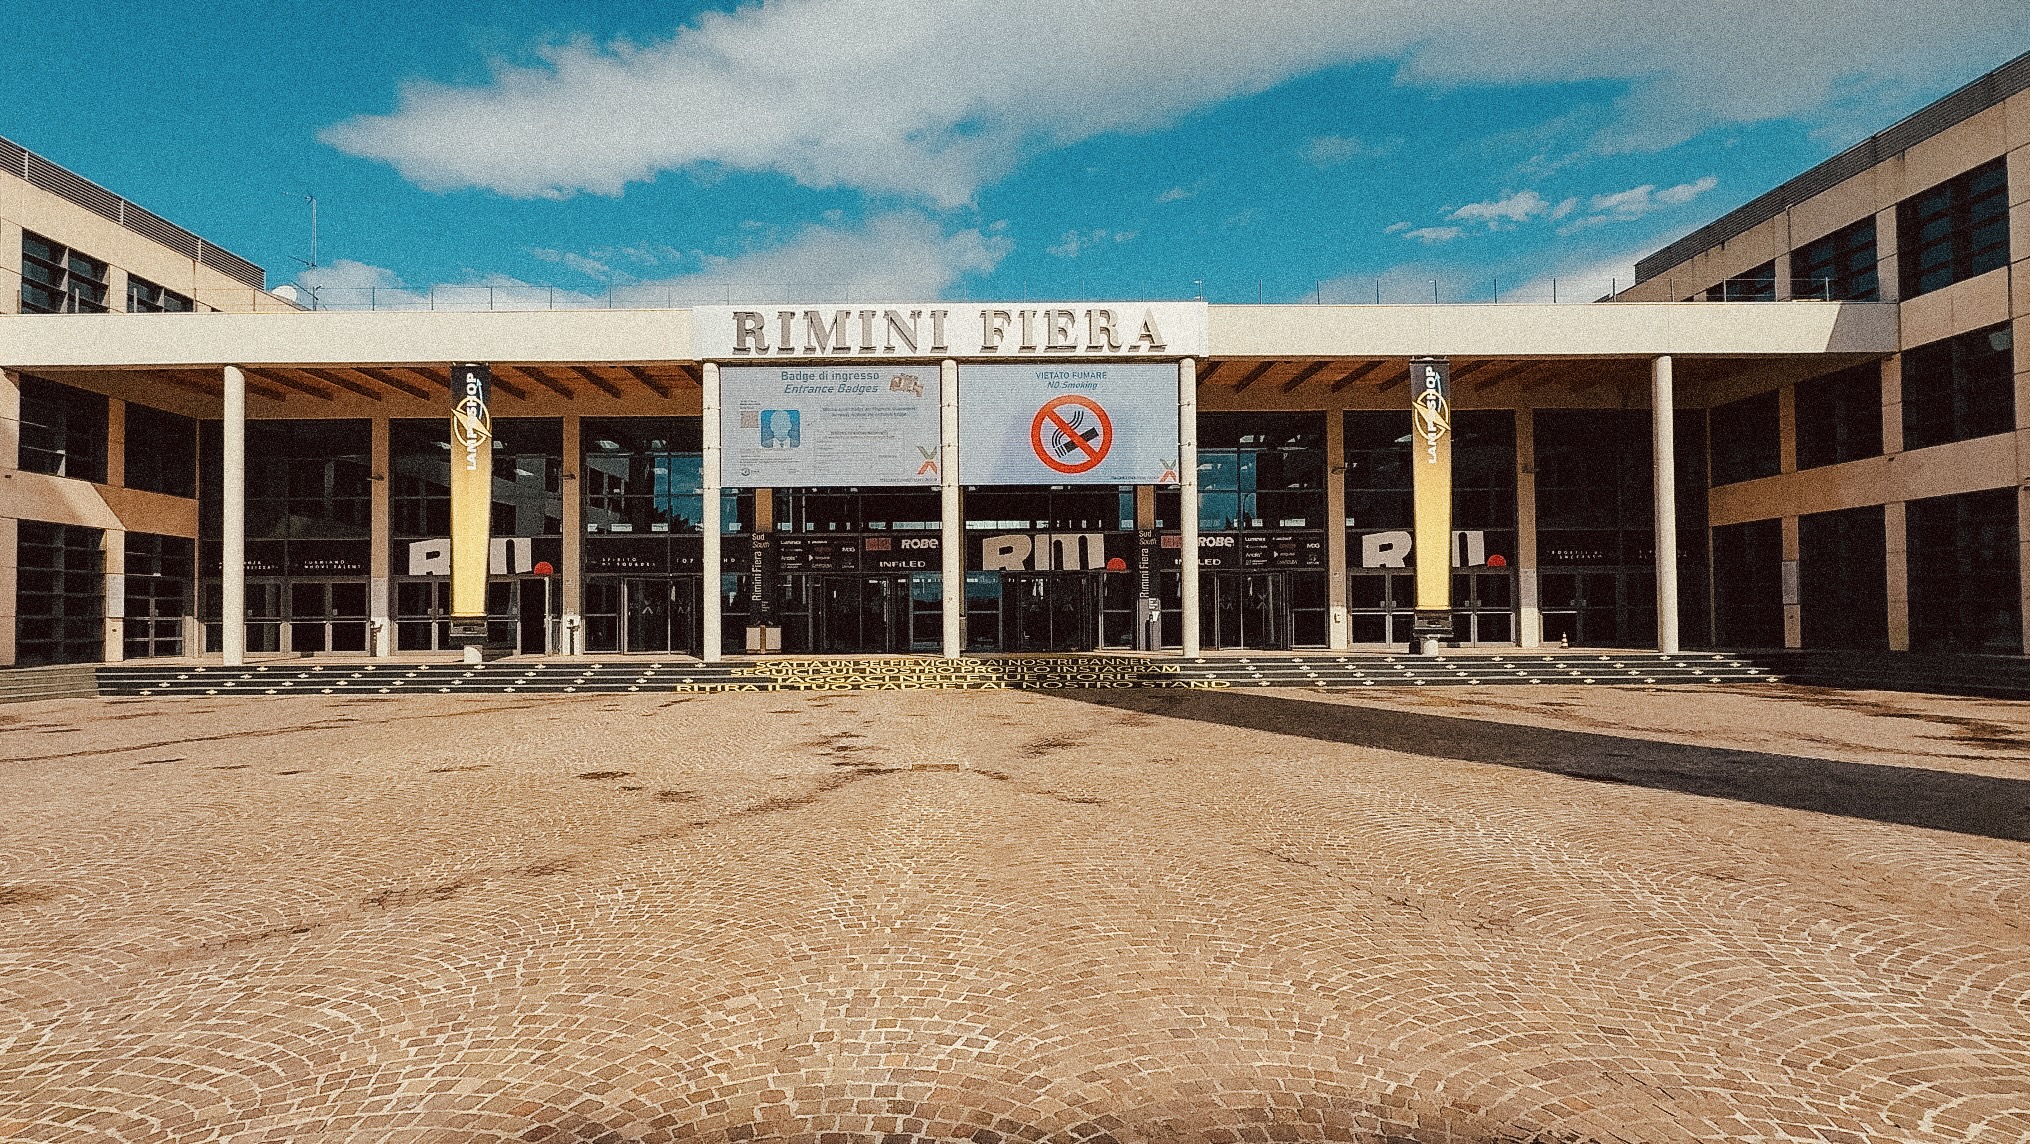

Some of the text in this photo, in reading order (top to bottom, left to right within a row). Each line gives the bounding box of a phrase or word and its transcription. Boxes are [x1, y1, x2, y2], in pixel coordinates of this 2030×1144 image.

[732, 308, 1167, 356] RIMINI FIERA
[781, 370, 880, 382] Badge di ingresso
[1036, 371, 1107, 380] VIETATO FUMARE
[784, 384, 878, 394] Entrance Badges
[1062, 380, 1098, 390] Smoking
[752, 551, 762, 601] Rimini Fiera
[1139, 548, 1150, 598] Rimini Fiera
[1057, 665, 1181, 673] INSTAGRAM
[772, 675, 890, 684] TAGGACI
[676, 684, 760, 692] RITIRA
